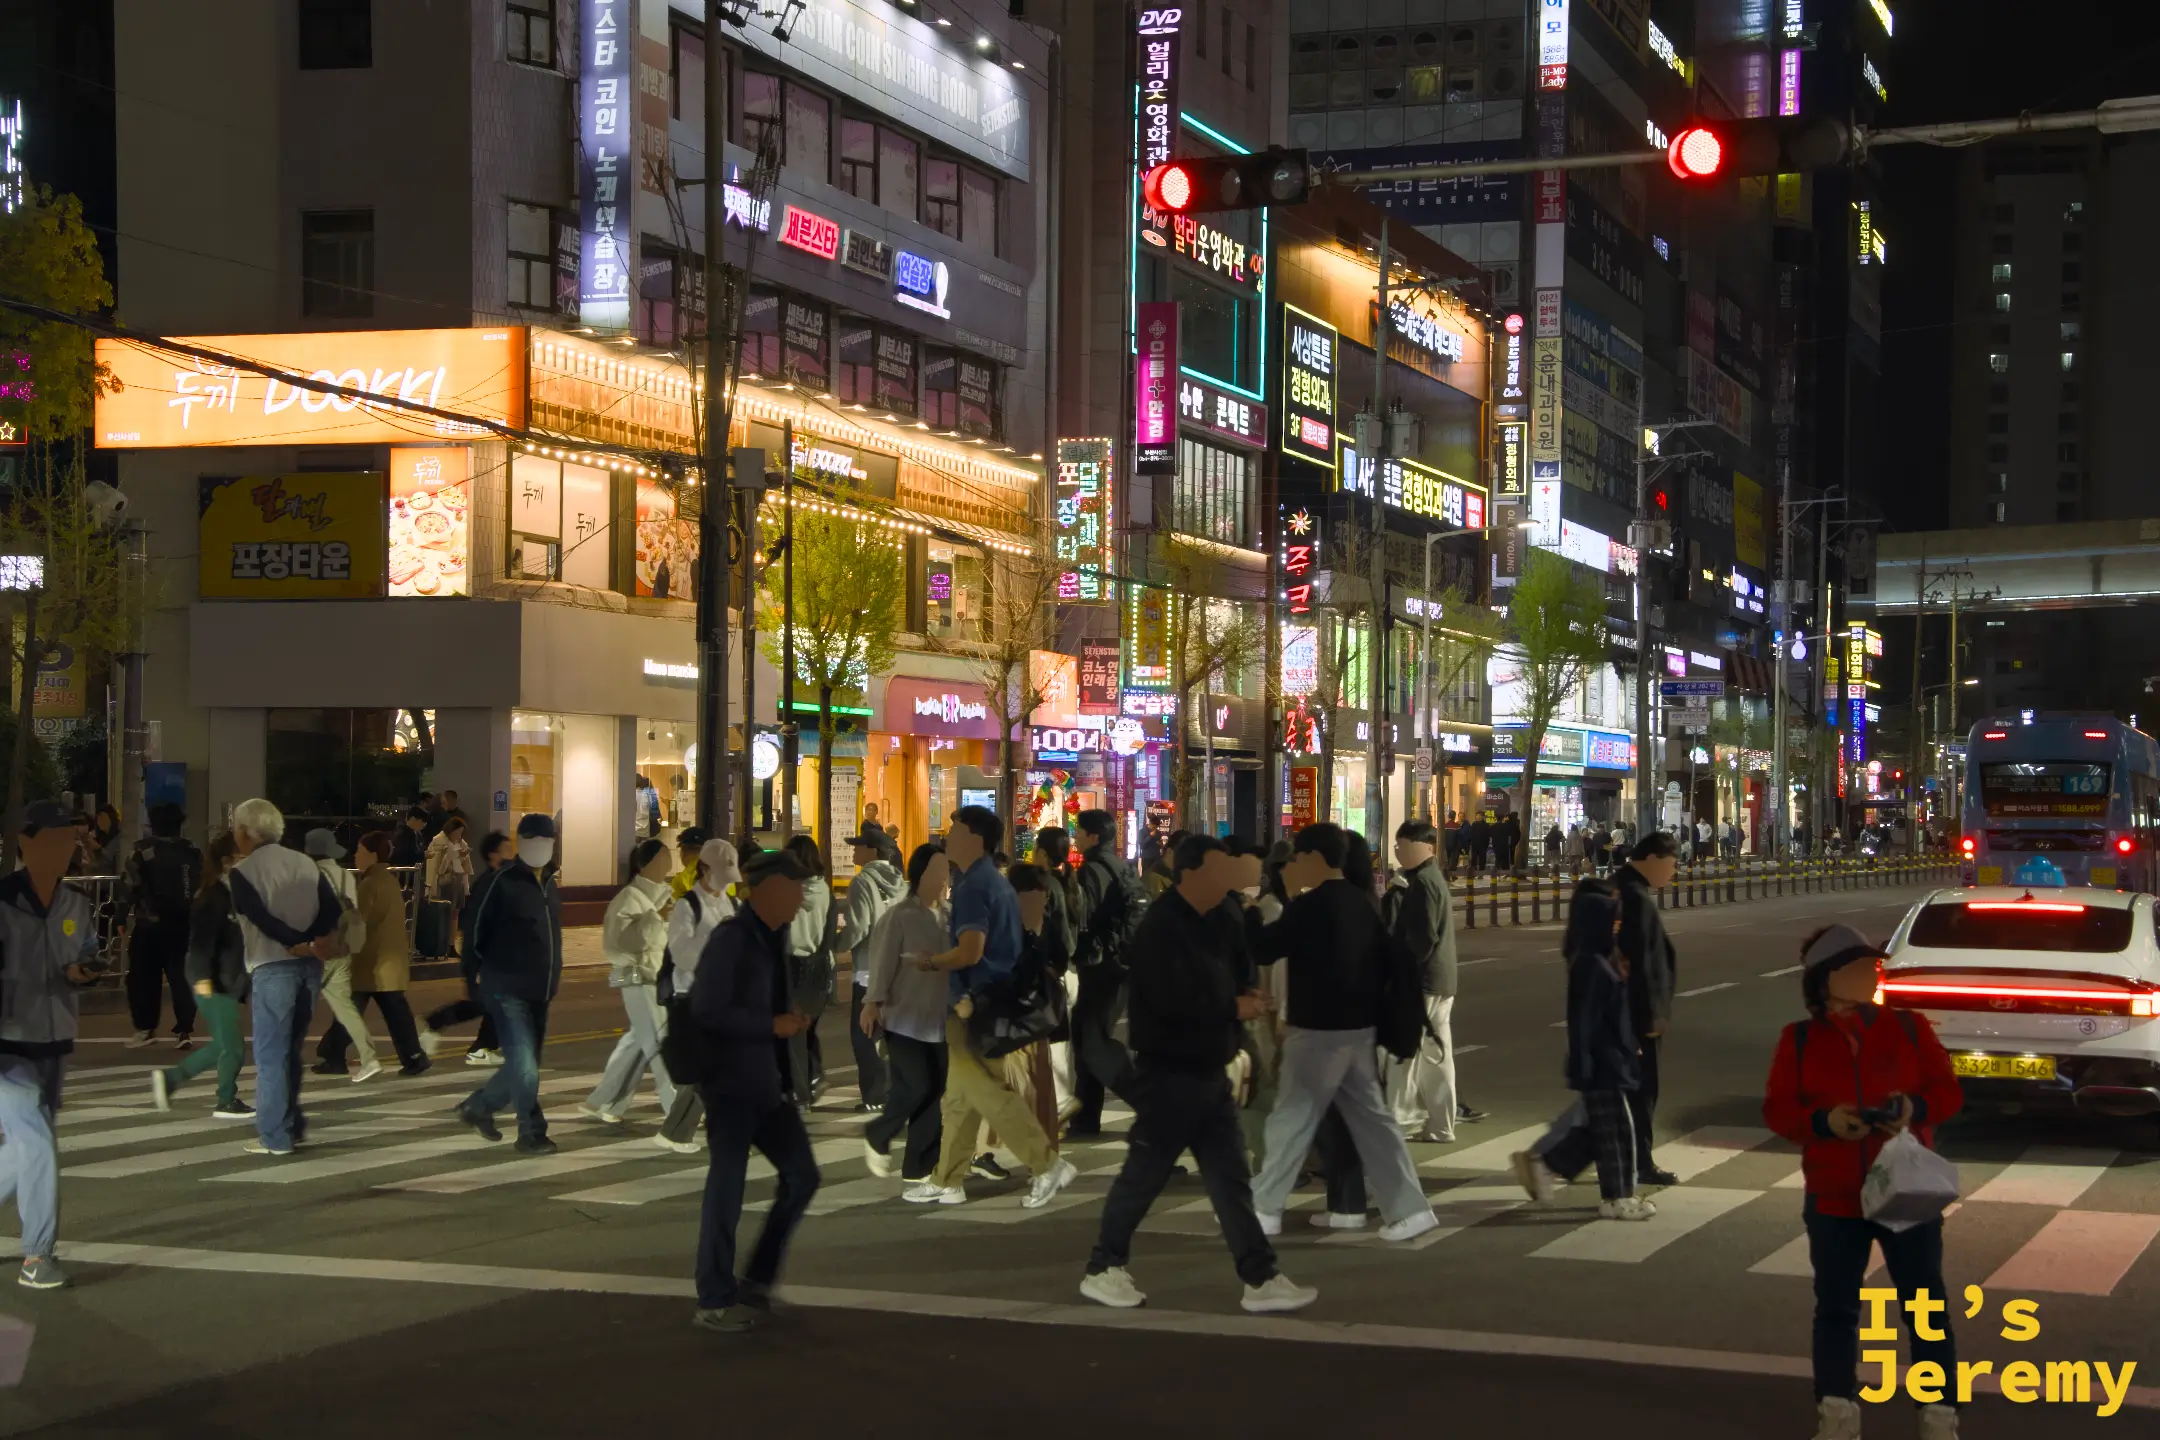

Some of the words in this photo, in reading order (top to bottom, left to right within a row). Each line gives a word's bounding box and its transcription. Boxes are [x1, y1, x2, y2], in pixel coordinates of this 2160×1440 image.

[1139, 8, 1181, 27] DVD
[845, 22, 880, 75] COIN
[883, 41, 939, 103] SINGING
[941, 72, 978, 125] ROOM
[1541, 67, 1566, 77] Hi-MO
[1541, 77, 1566, 88] Lady
[594, 78, 618, 135] 코인
[787, 211, 837, 255] 세븐스타
[899, 254, 931, 293] 연습장
[785, 302, 823, 336] 세븐스타
[877, 335, 912, 365] 세븐스타
[960, 362, 991, 391] 세븐스타
[1291, 365, 1329, 415] 정형외과
[168, 366, 238, 430] 두끼
[263, 365, 447, 417] DOOKKI
[1290, 412, 1301, 438] 3F
[413, 462, 441, 485] 두끼
[1540, 466, 1554, 477] 4F
[1507, 509, 1516, 537] OLVE
[231, 542, 350, 580] 포장타운
[1507, 539, 1515, 573] YOUNG
[1106, 661, 1119, 700] 연습장
[941, 693, 961, 723] BR
[2070, 776, 2103, 792] 169
[2006, 1060, 2049, 1076] 1546
